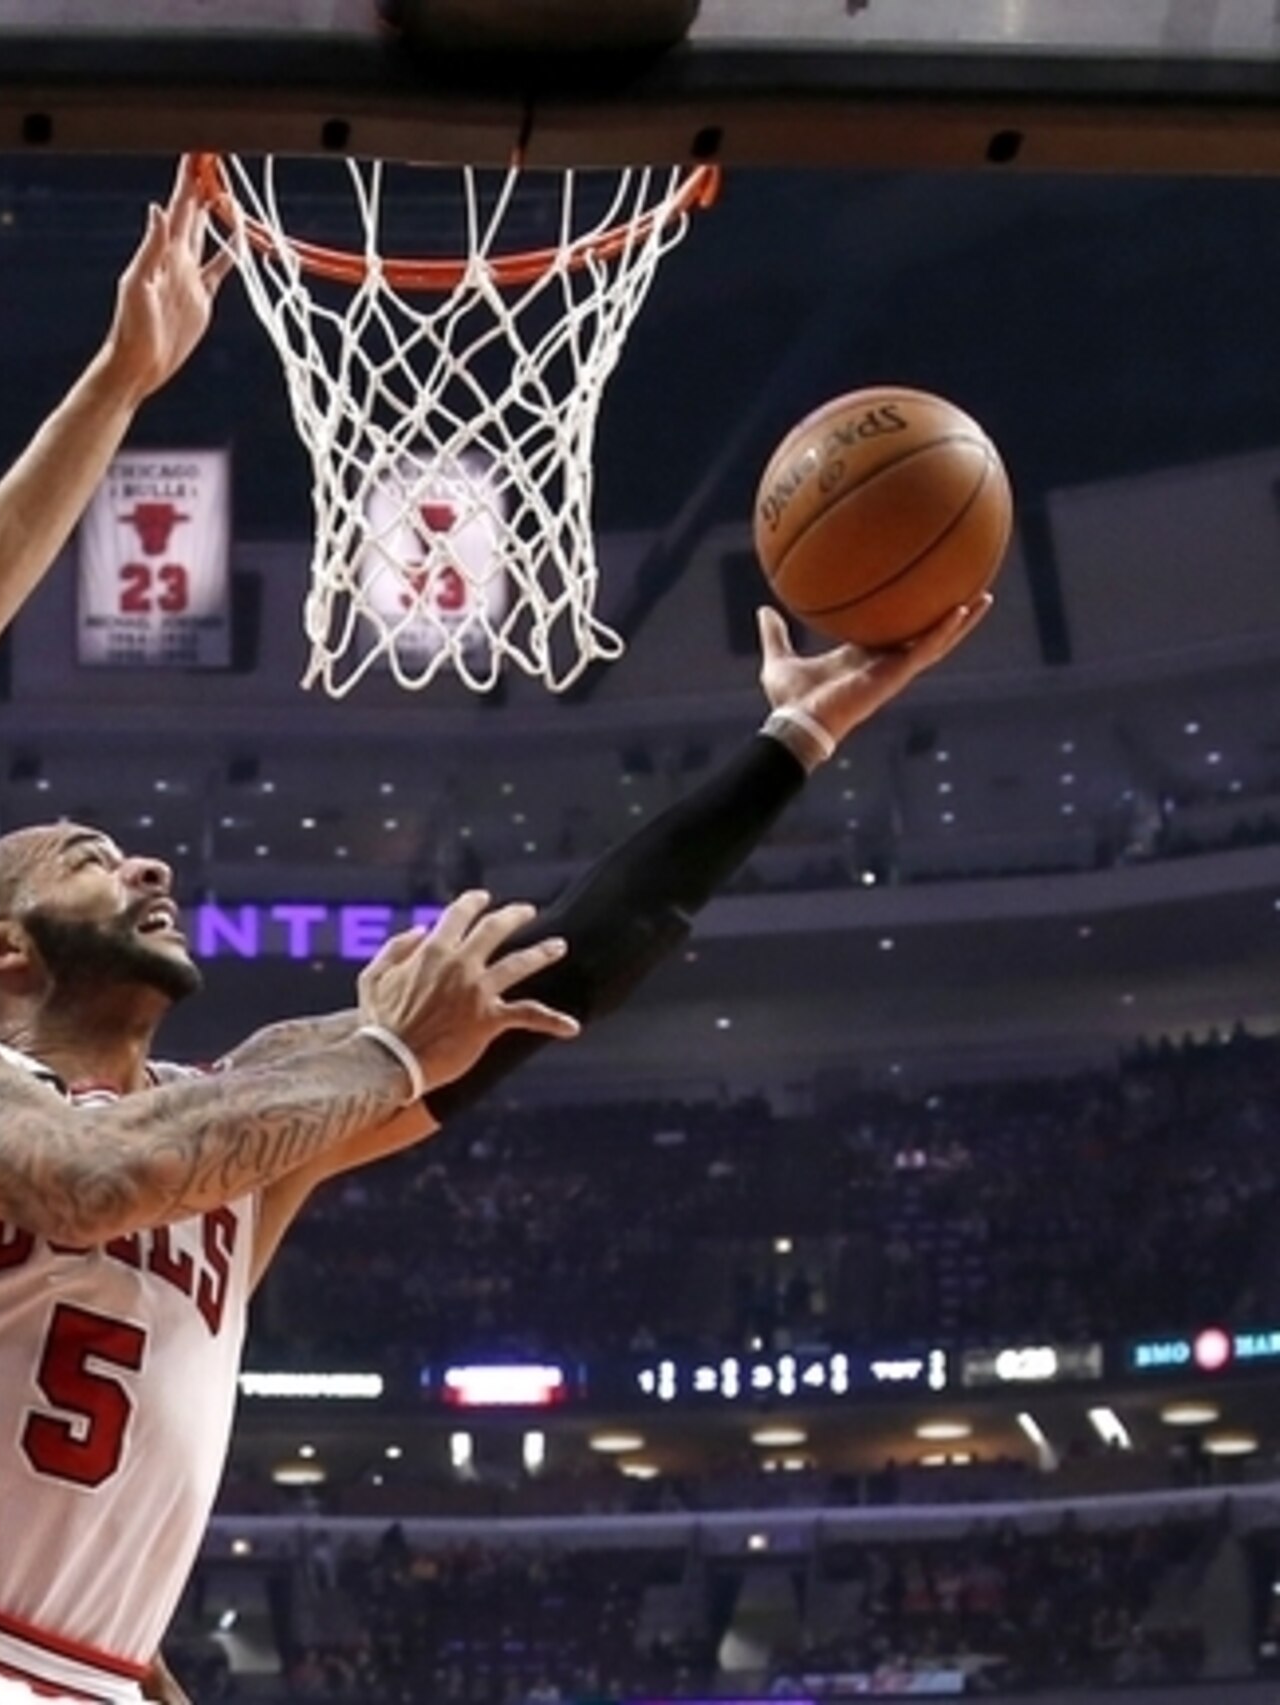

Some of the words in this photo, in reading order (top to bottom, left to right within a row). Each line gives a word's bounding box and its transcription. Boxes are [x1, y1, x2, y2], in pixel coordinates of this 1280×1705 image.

[119, 564, 190, 614] 23
[198, 904, 446, 957] NTE
[19, 1300, 148, 1490] 5
